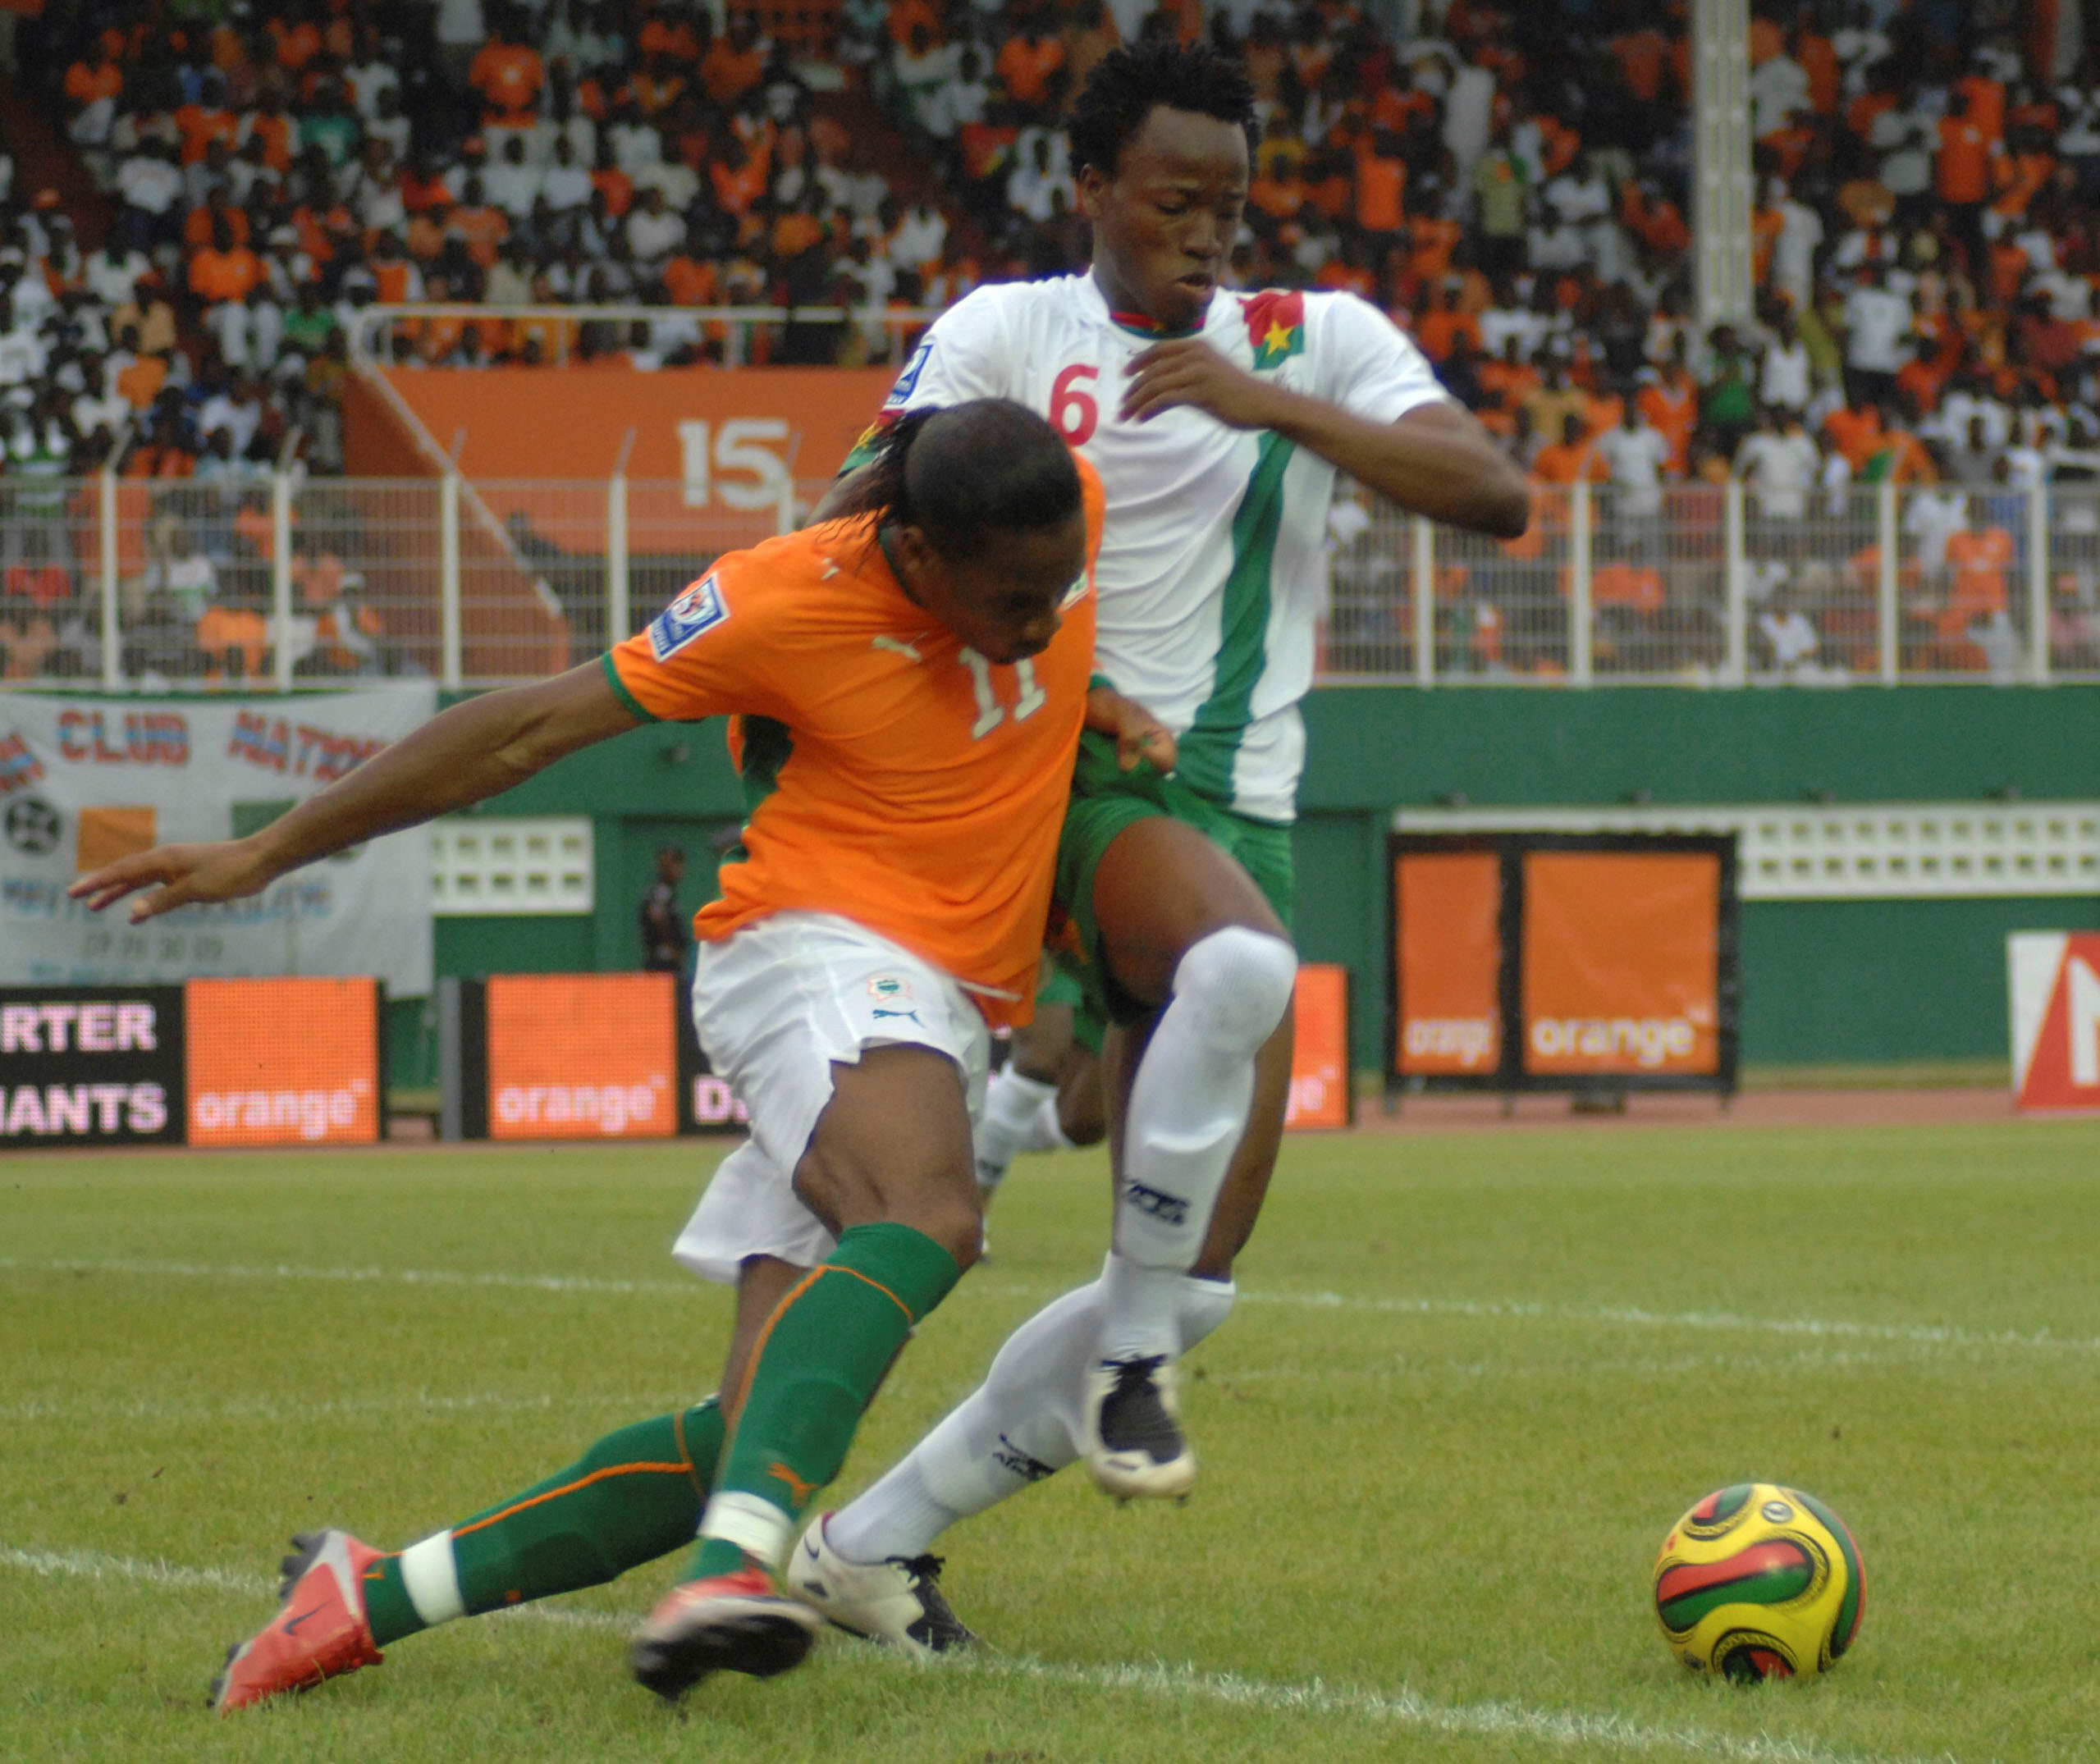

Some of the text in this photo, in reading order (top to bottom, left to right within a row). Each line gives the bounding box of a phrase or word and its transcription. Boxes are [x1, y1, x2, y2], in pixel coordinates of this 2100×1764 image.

[1050, 363, 1100, 447] 6
[677, 420, 793, 510] 15
[958, 647, 1046, 740] 11
[59, 709, 188, 766] CLUB
[1532, 1016, 1694, 1067] orange
[196, 1090, 358, 1140] orange
[498, 1085, 655, 1134] orange
